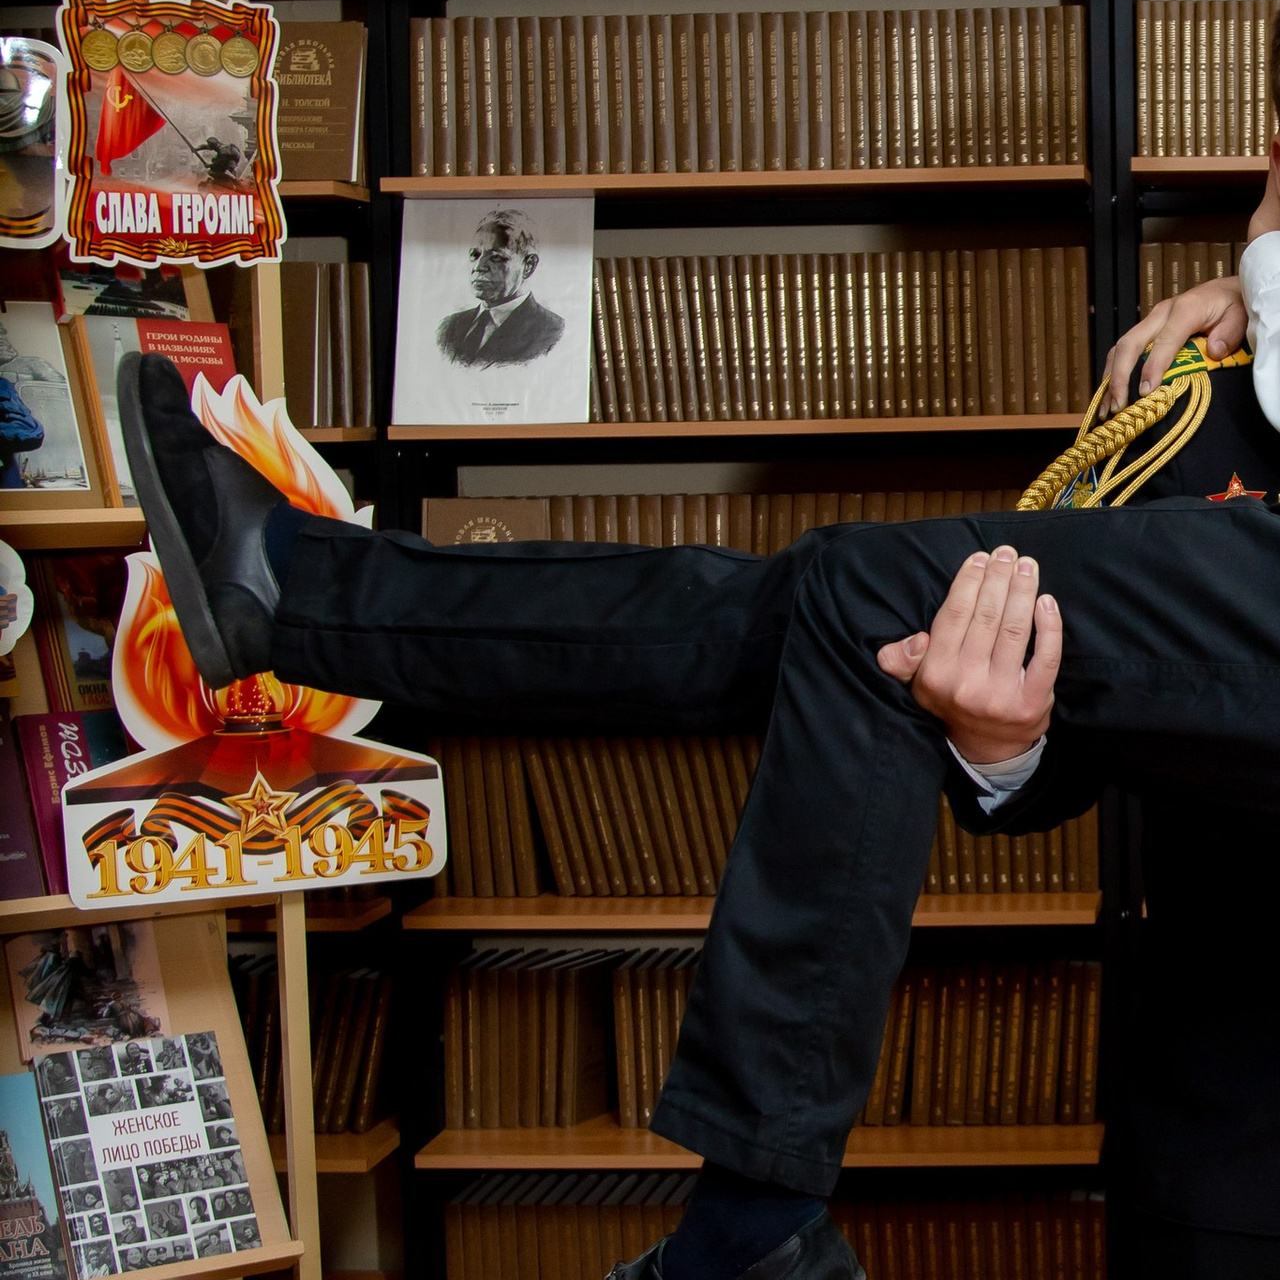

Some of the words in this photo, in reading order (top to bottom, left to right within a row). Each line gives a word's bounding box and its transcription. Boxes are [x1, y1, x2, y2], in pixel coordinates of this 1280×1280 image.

[274, 70, 332, 86] БИБЛИОТЕКА
[294, 98, 330, 107] ТОЛСТОЙ
[96, 191, 162, 234] СЛАВА
[172, 193, 255, 236] ГЕРОЯМ!
[146, 332, 178, 342] ГЕРОИ
[180, 334, 222, 344] РОДИНЫ
[156, 344, 216, 354] НАЗВАНИЯХ
[180, 356, 224, 365] МОСКВЫ
[477, 517, 514, 542] ШКОЛЬНА
[78, 684, 108, 695] ОКНА
[82, 694, 110, 706] ТАСС
[40, 724, 55, 768] Ефимов
[50, 770, 61, 804] Борис
[86, 818, 434, 899] 1941-1945
[112, 1110, 181, 1136] ЖЕНСКОЕ
[102, 1142, 140, 1165] ЛИЦО
[144, 1133, 202, 1157] ПОБЕДЫ
